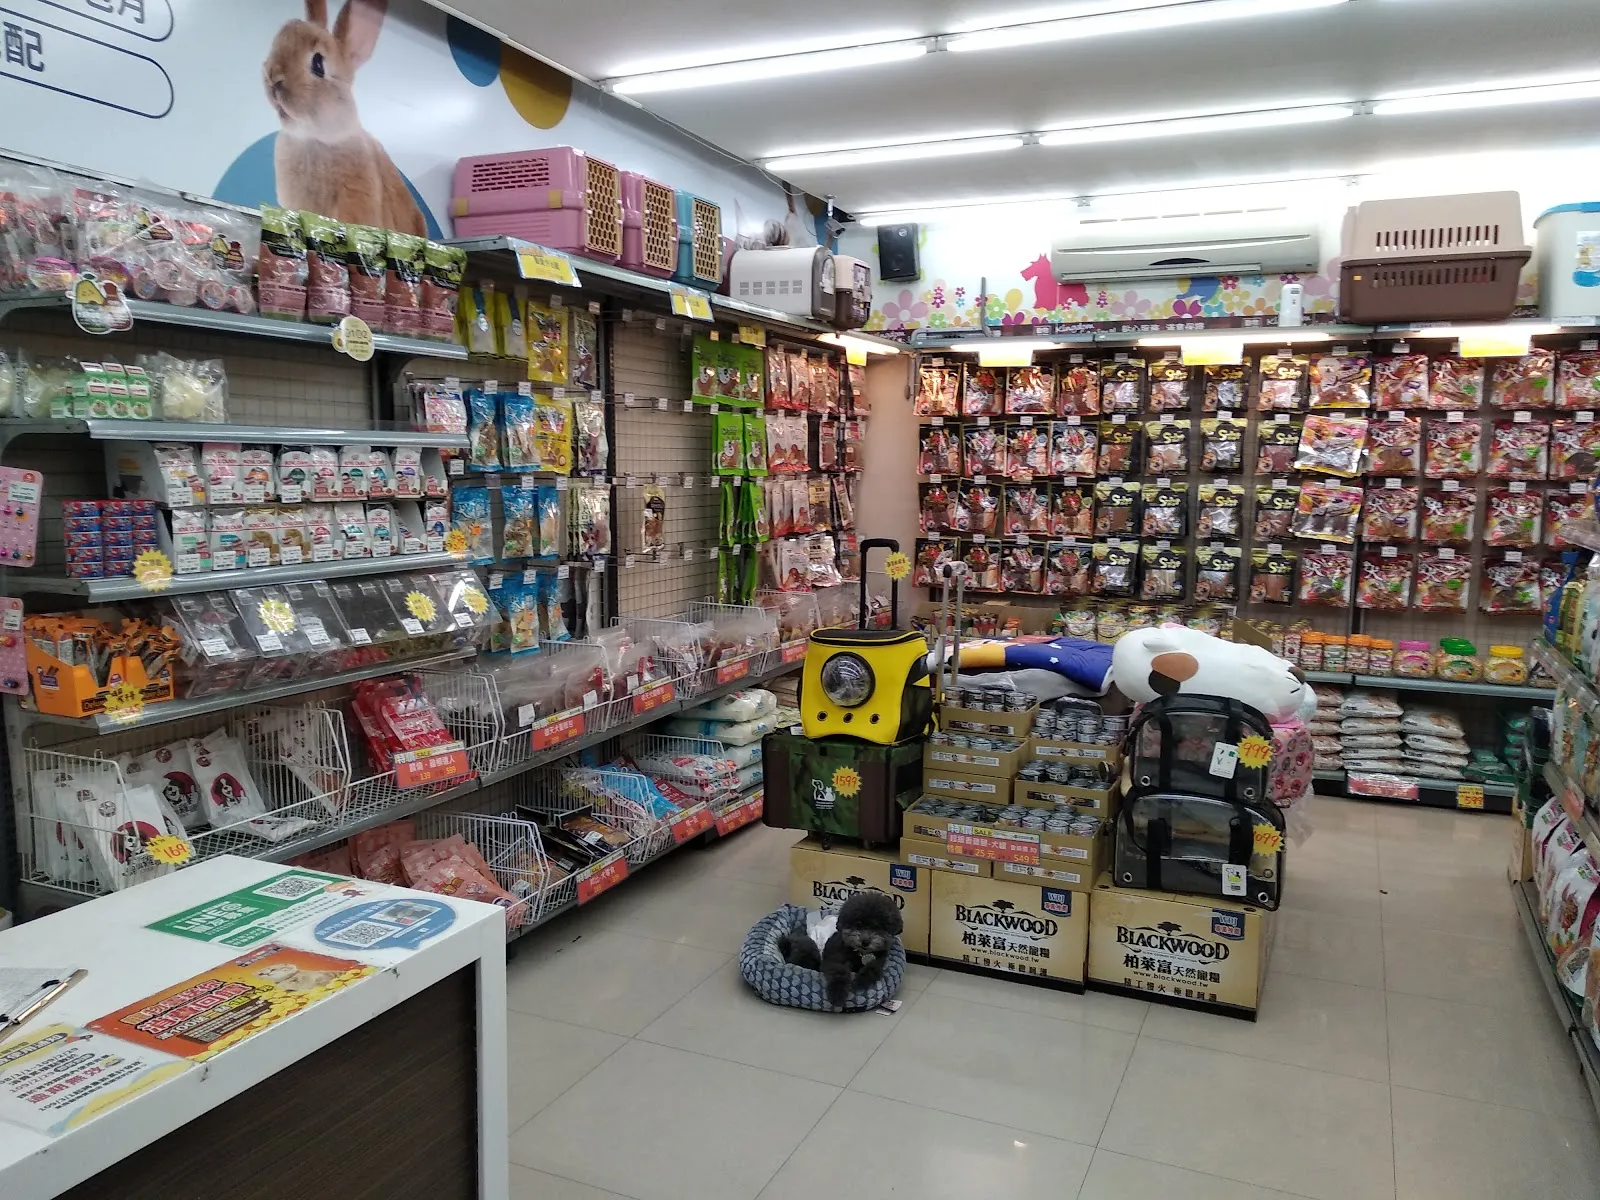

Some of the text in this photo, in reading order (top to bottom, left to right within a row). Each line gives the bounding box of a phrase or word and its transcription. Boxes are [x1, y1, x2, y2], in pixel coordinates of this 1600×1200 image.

[1243, 742, 1270, 760] 999
[835, 775, 857, 788] 1599
[973, 827, 993, 836] SALE
[1252, 830, 1280, 848] 099
[163, 843, 188, 859] 169
[947, 844, 1040, 865] 特價 25 元 549 元
[173, 901, 242, 930] LINE@
[955, 903, 1059, 937] BLACKWOOD
[1116, 925, 1230, 961] BLACKWOOD
[970, 946, 1041, 963] www.blackwood.tw
[1133, 970, 1209, 988] www.blackwood.tw
